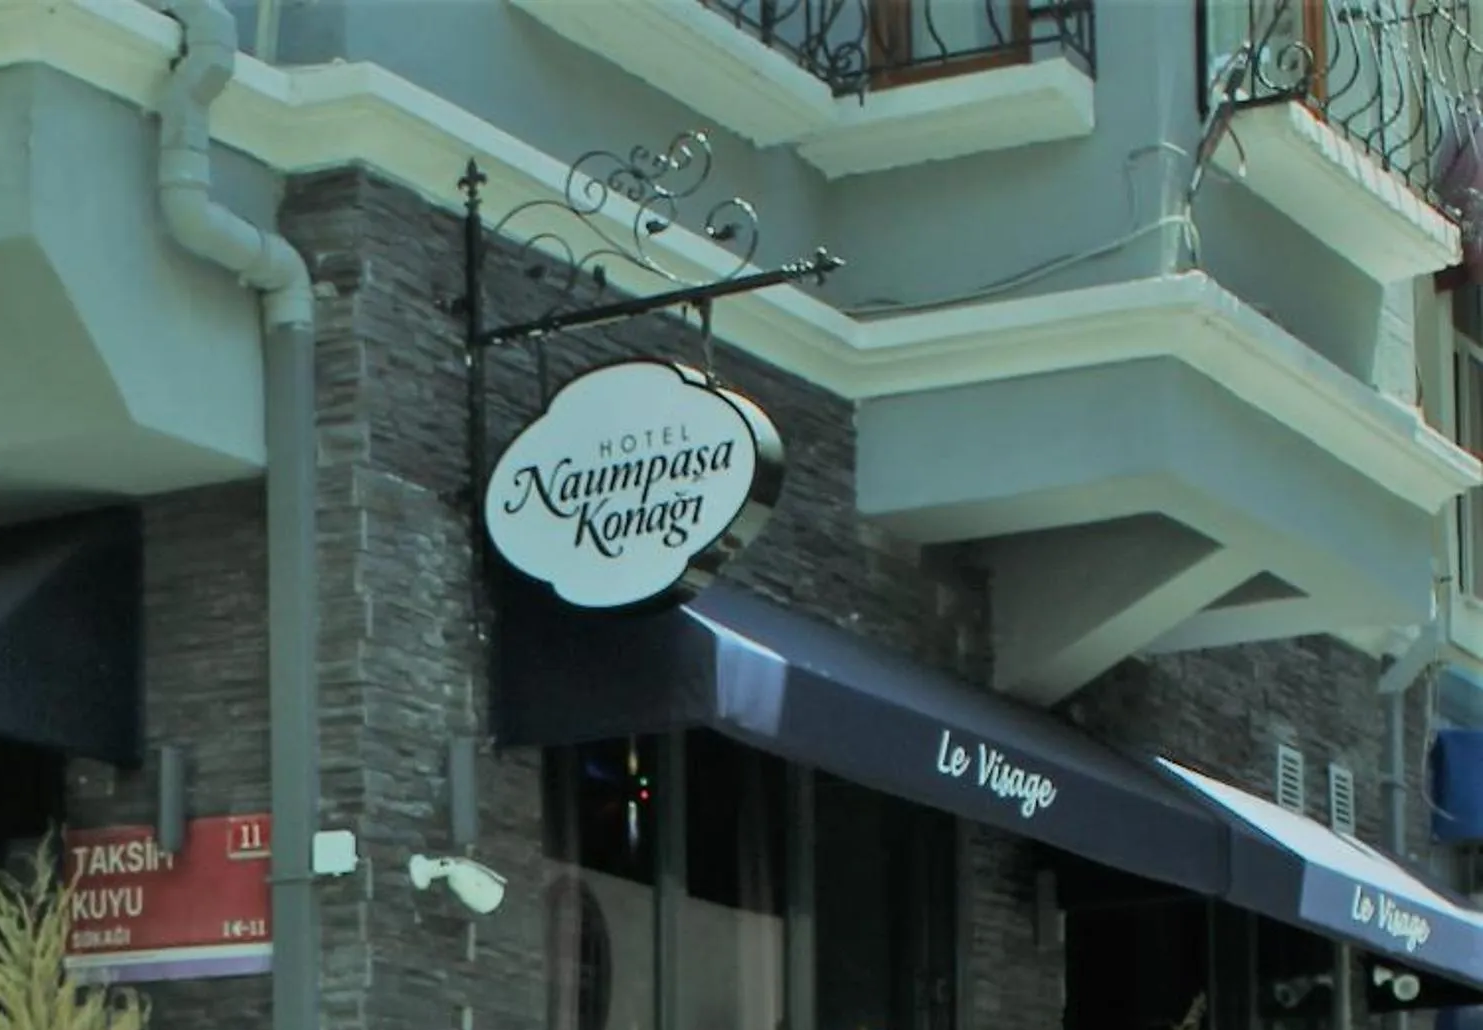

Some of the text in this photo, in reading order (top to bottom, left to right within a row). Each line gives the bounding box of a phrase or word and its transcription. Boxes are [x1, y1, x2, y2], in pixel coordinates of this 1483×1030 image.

[599, 424, 690, 457] HOTEL
[504, 439, 734, 518] Naumpaşa
[574, 491, 704, 558] Konağı
[937, 729, 1058, 818] Le Visage
[241, 823, 262, 849] 11
[72, 886, 144, 922] KUYU
